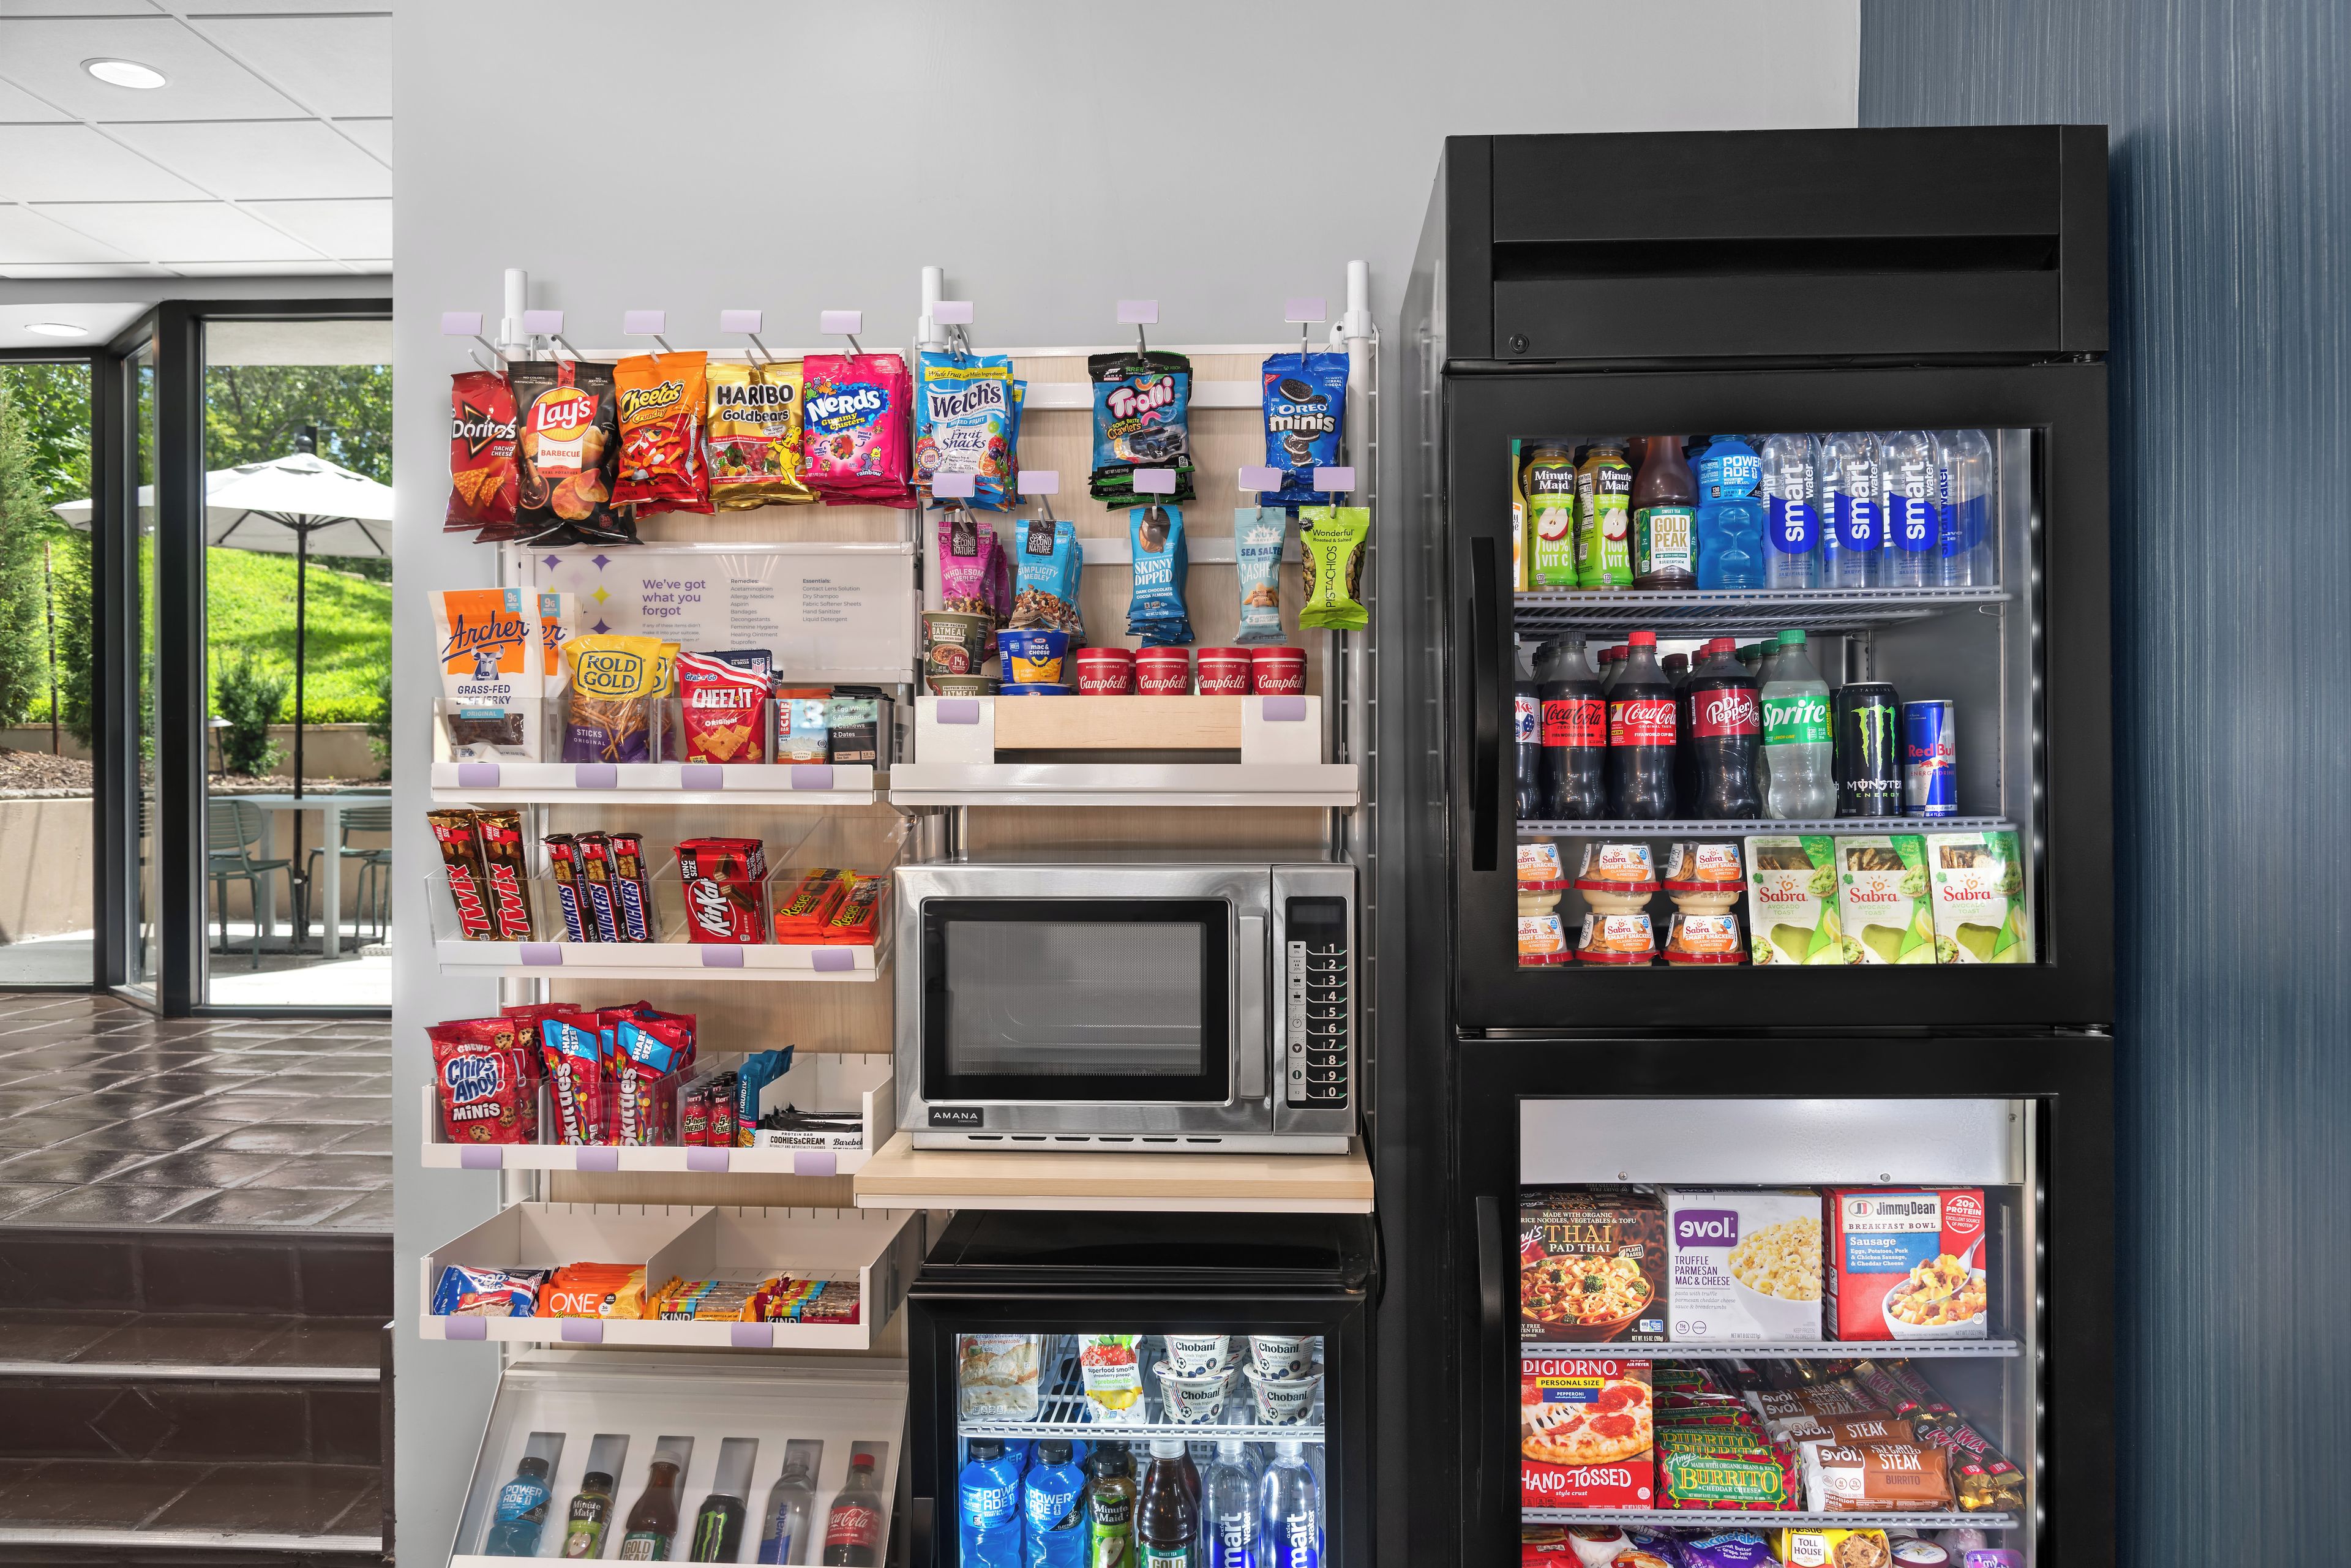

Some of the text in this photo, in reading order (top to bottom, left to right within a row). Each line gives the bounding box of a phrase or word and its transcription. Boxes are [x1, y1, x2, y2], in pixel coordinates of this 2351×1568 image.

[621, 381, 684, 422] Cheetos
[717, 384, 793, 406] HARIBO
[930, 383, 1002, 418] Welch's
[1108, 376, 1174, 419] Trolli
[537, 396, 593, 430] Lay's
[632, 408, 667, 422] Crunchy
[1277, 403, 1328, 415] OREO
[722, 410, 789, 422] Goldbears
[822, 412, 858, 427] Gummy
[1269, 413, 1335, 432] minis
[452, 419, 517, 439] Doritos
[830, 416, 866, 430] Clusters
[1722, 456, 1762, 467] POWER
[1534, 470, 1573, 481] Minute
[1723, 467, 1750, 477] ADE
[1539, 480, 1570, 490] Maid
[1805, 463, 1814, 499] water
[1780, 463, 1804, 542] smart
[1654, 517, 1688, 533] GOLD
[1028, 536, 1052, 546] SECOND
[1654, 533, 1688, 549] PEAK
[1028, 544, 1052, 553] NATURE
[1134, 558, 1172, 574] SKINNY
[1542, 554, 1569, 568] VIT C
[1018, 566, 1059, 579] SIMPLICITY
[1134, 569, 1173, 586] DIPPED
[1326, 546, 1337, 607] PISTACHIOS
[643, 579, 706, 591] We've got
[643, 593, 701, 604] what you
[643, 606, 681, 617] forgot
[442, 610, 530, 655] Archer
[932, 628, 966, 636] OATMEAL
[587, 655, 637, 673] ROLD
[584, 672, 636, 688] GOLD
[1139, 673, 1187, 691] Campbell's
[457, 685, 511, 694] GRASS-FED
[1724, 696, 1740, 710] Dr
[780, 702, 789, 726] CLIF
[1706, 702, 1750, 725] Pepper
[1763, 699, 1826, 732] Sprite
[577, 729, 602, 738] STICKS
[1908, 743, 1955, 757] Red Bull
[1602, 855, 1626, 864] Sabra
[1760, 887, 1806, 903] Sabra
[620, 878, 647, 941] SNICKERS
[1329, 943, 1335, 953] 1
[1329, 959, 1336, 969] 2
[1329, 975, 1336, 985] 3
[1329, 991, 1337, 1001] 4
[1329, 1007, 1336, 1017] 5
[1329, 1023, 1336, 1033] 6
[1329, 1039, 1336, 1049] 7
[1329, 1055, 1336, 1065] 8
[446, 1055, 494, 1082] Chips
[1329, 1071, 1336, 1081] 9
[1329, 1087, 1336, 1097] 0
[1877, 1201, 1935, 1217] Jimmy Dean
[1946, 1207, 1982, 1216] PROTEIN
[1549, 1243, 1610, 1253] PAD THAI
[1850, 1237, 1896, 1247] Sausage
[1674, 1256, 1709, 1265] TRUFFLE
[1674, 1266, 1718, 1275] PARMESAN
[1674, 1276, 1730, 1286] MAC & CHEESE
[550, 1292, 598, 1313] ONE
[1175, 1342, 1216, 1352] Chobani
[1266, 1390, 1309, 1401] Chobani
[1679, 1468, 1778, 1494] BURRITO
[1029, 1491, 1074, 1504] POWER
